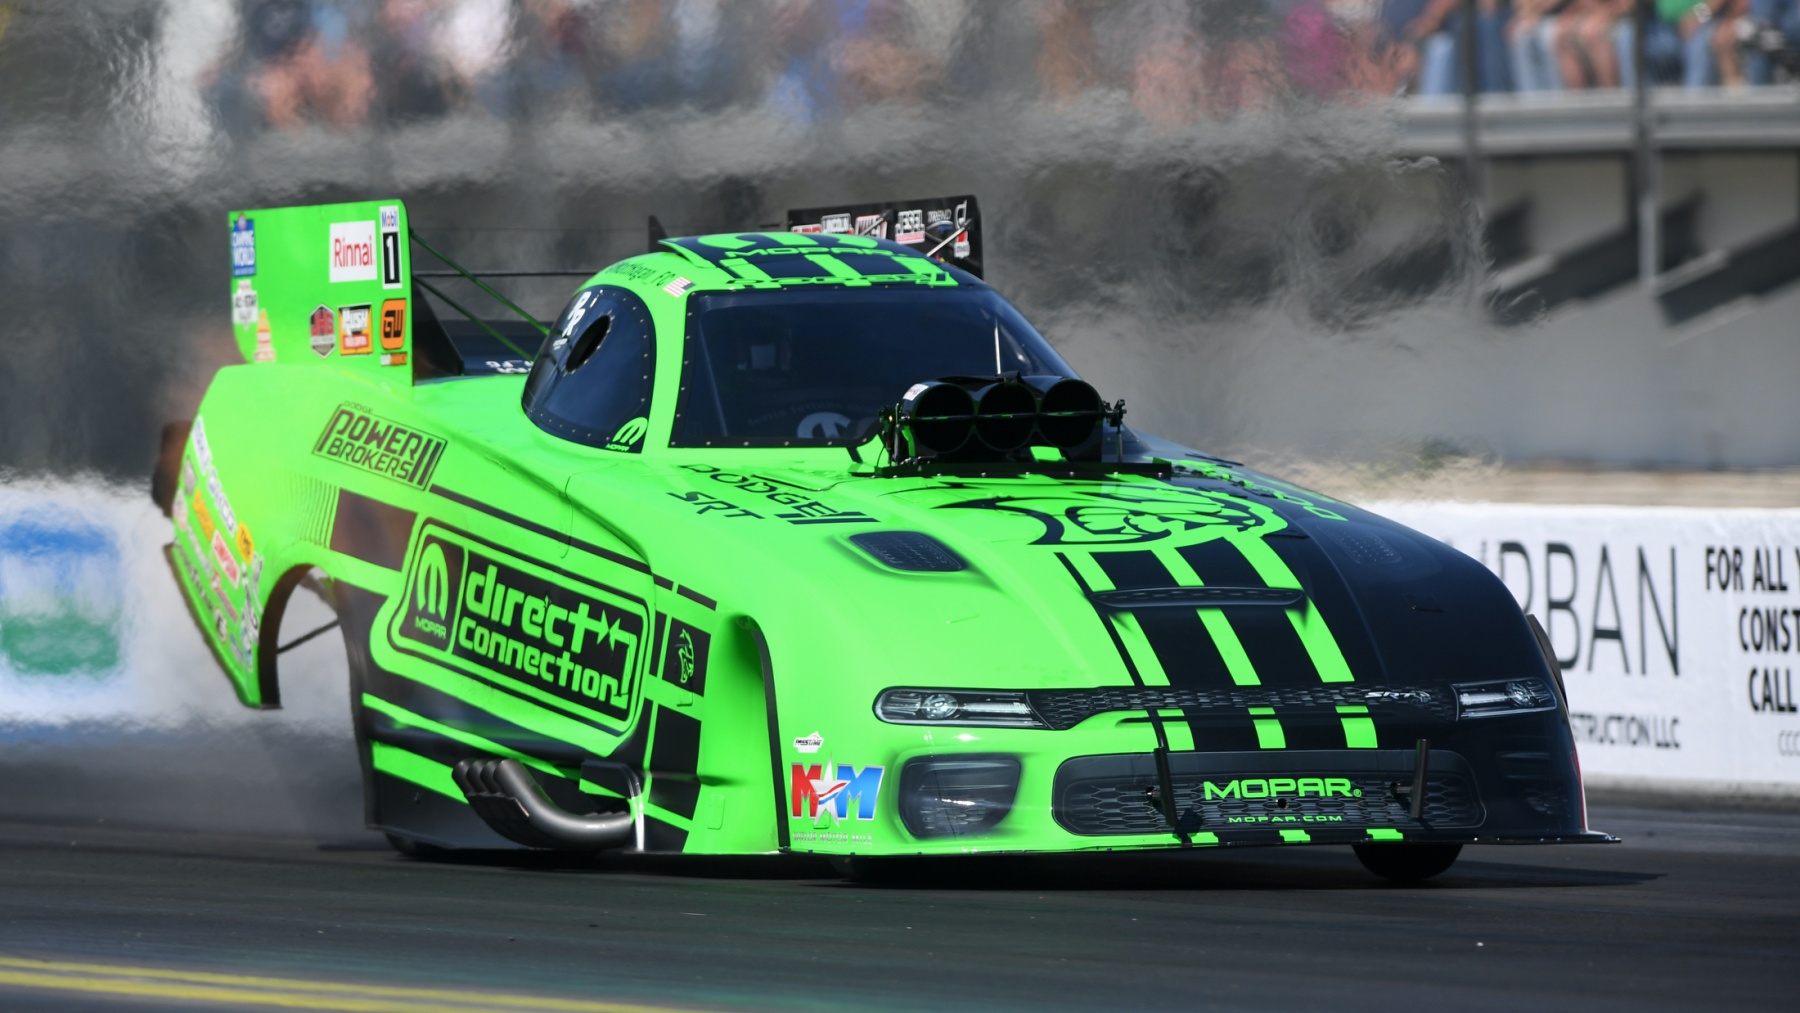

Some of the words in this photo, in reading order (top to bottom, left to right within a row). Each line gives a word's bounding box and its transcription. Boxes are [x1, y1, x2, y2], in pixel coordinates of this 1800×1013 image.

[382, 211, 398, 228] Mobil
[334, 235, 373, 268] Rinnai
[386, 235, 395, 281] 1
[725, 247, 895, 258] MOPAR
[343, 400, 374, 415] DODGE
[317, 408, 423, 461] POWER
[326, 437, 413, 480] BROKERS
[666, 491, 766, 519] SRT
[678, 463, 840, 518] DODGE
[1706, 546, 1743, 591] FOR
[1752, 547, 1788, 591] ALL
[415, 616, 447, 640] MOPAR
[465, 564, 596, 654] direct
[458, 616, 624, 706] connection
[1748, 668, 1797, 712] CALL
[1653, 717, 1680, 748] LLC
[1229, 815, 1343, 823] MOPAR.COM
